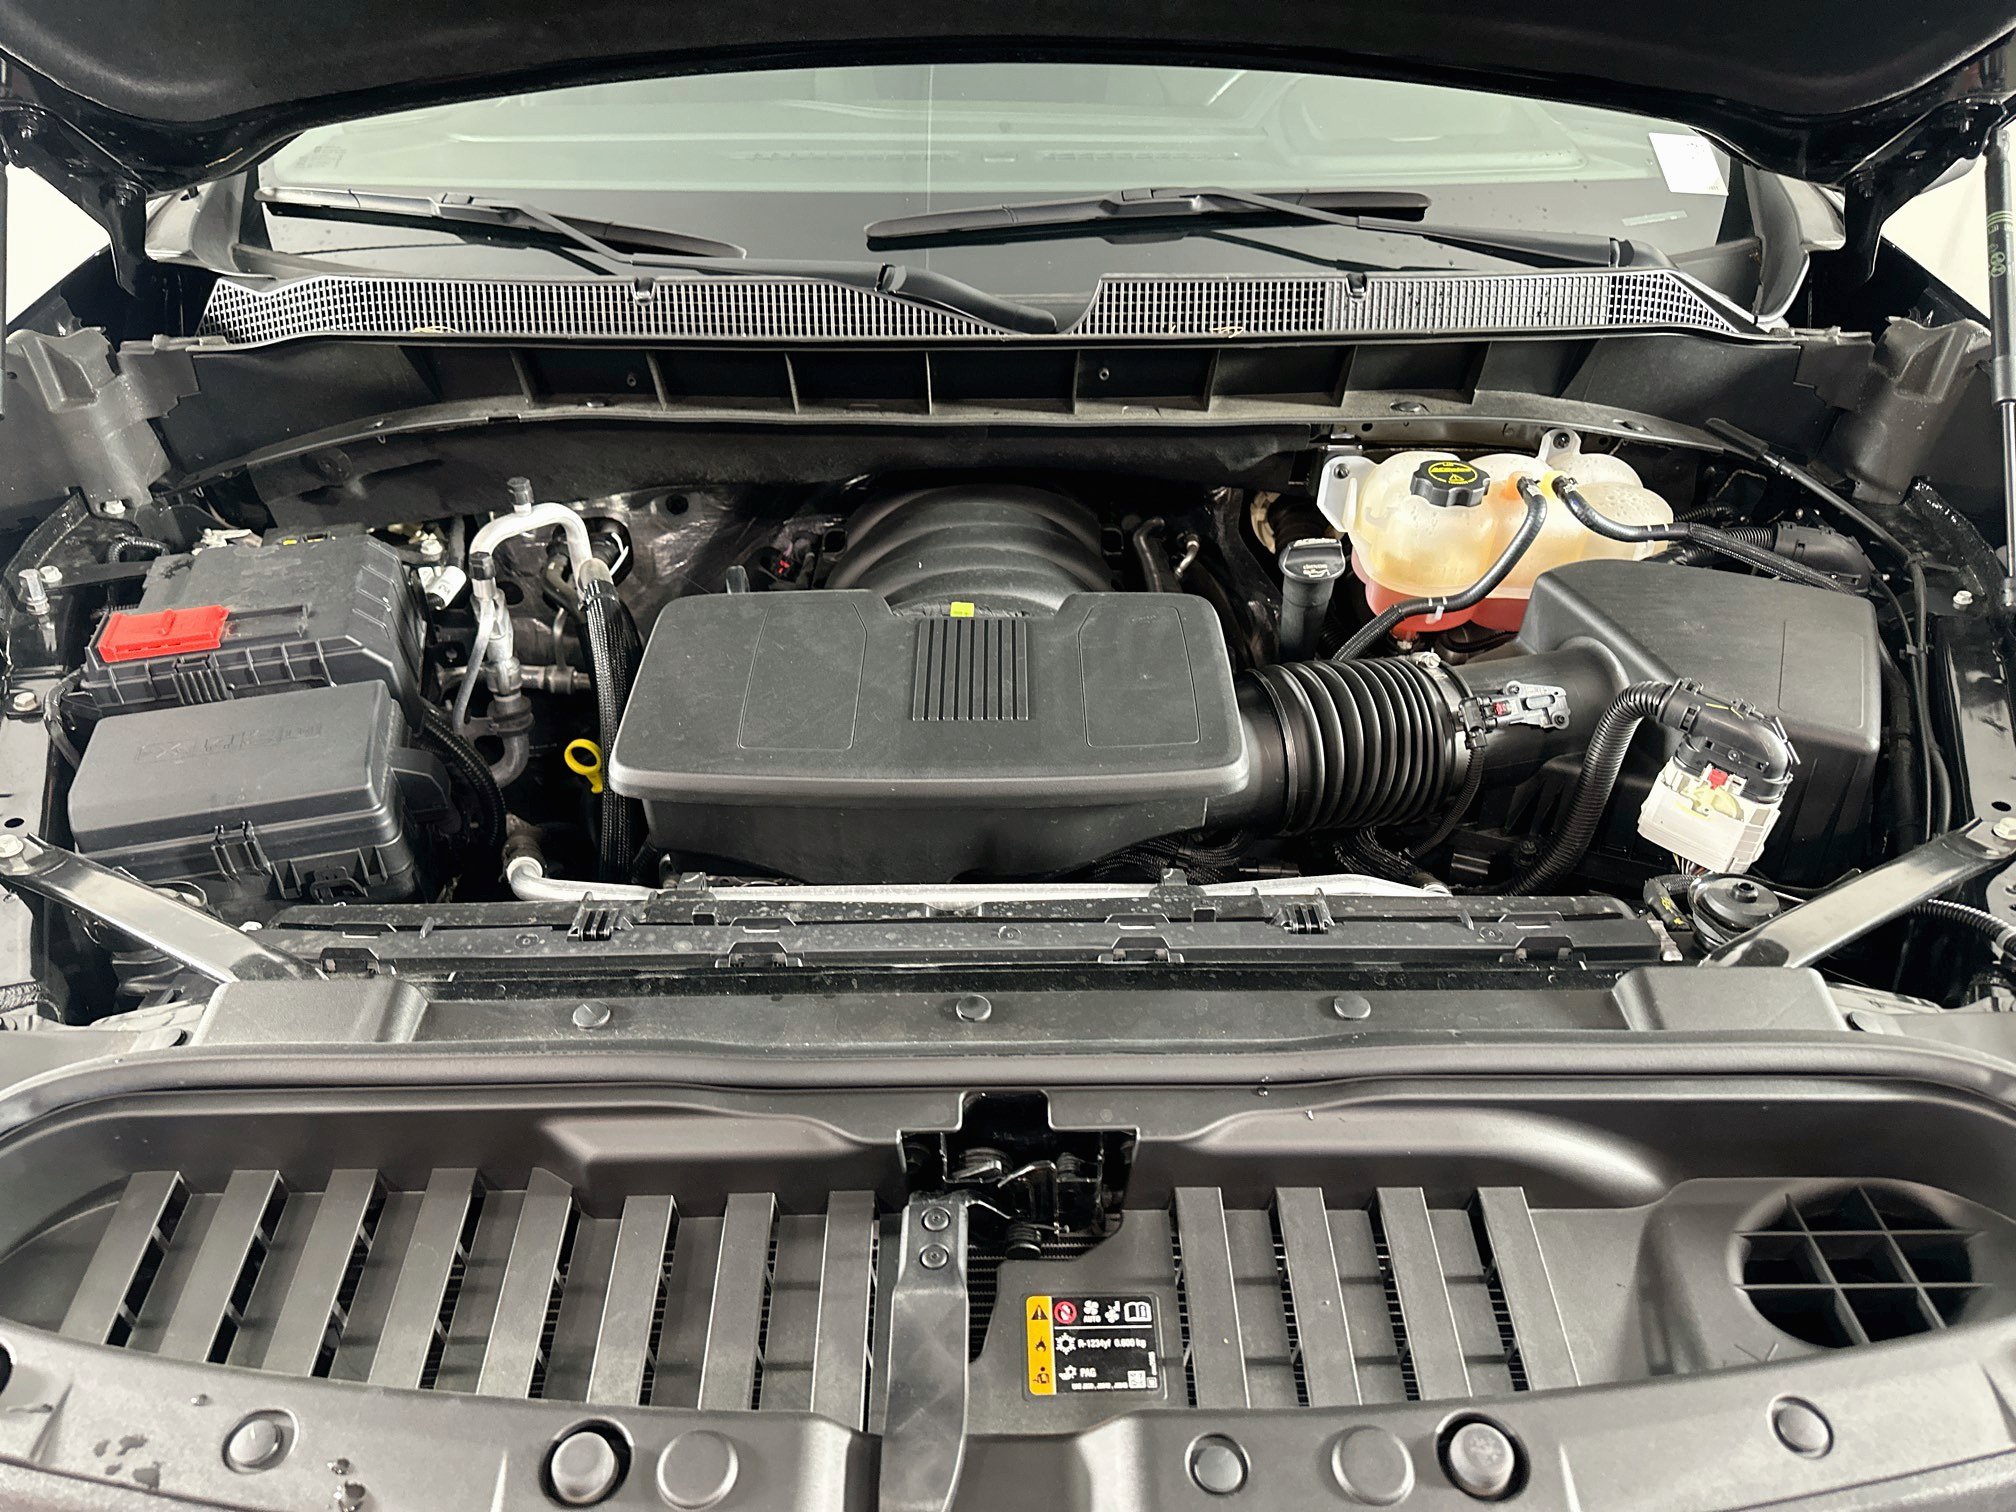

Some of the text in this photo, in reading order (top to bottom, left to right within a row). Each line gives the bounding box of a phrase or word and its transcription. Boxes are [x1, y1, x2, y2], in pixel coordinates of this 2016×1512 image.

[1083, 1315, 1101, 1323] AUTO
[1078, 1339, 1111, 1349] R-1234yf
[1136, 1338, 1146, 1348] kg
[1079, 1367, 1097, 1378] PAG
